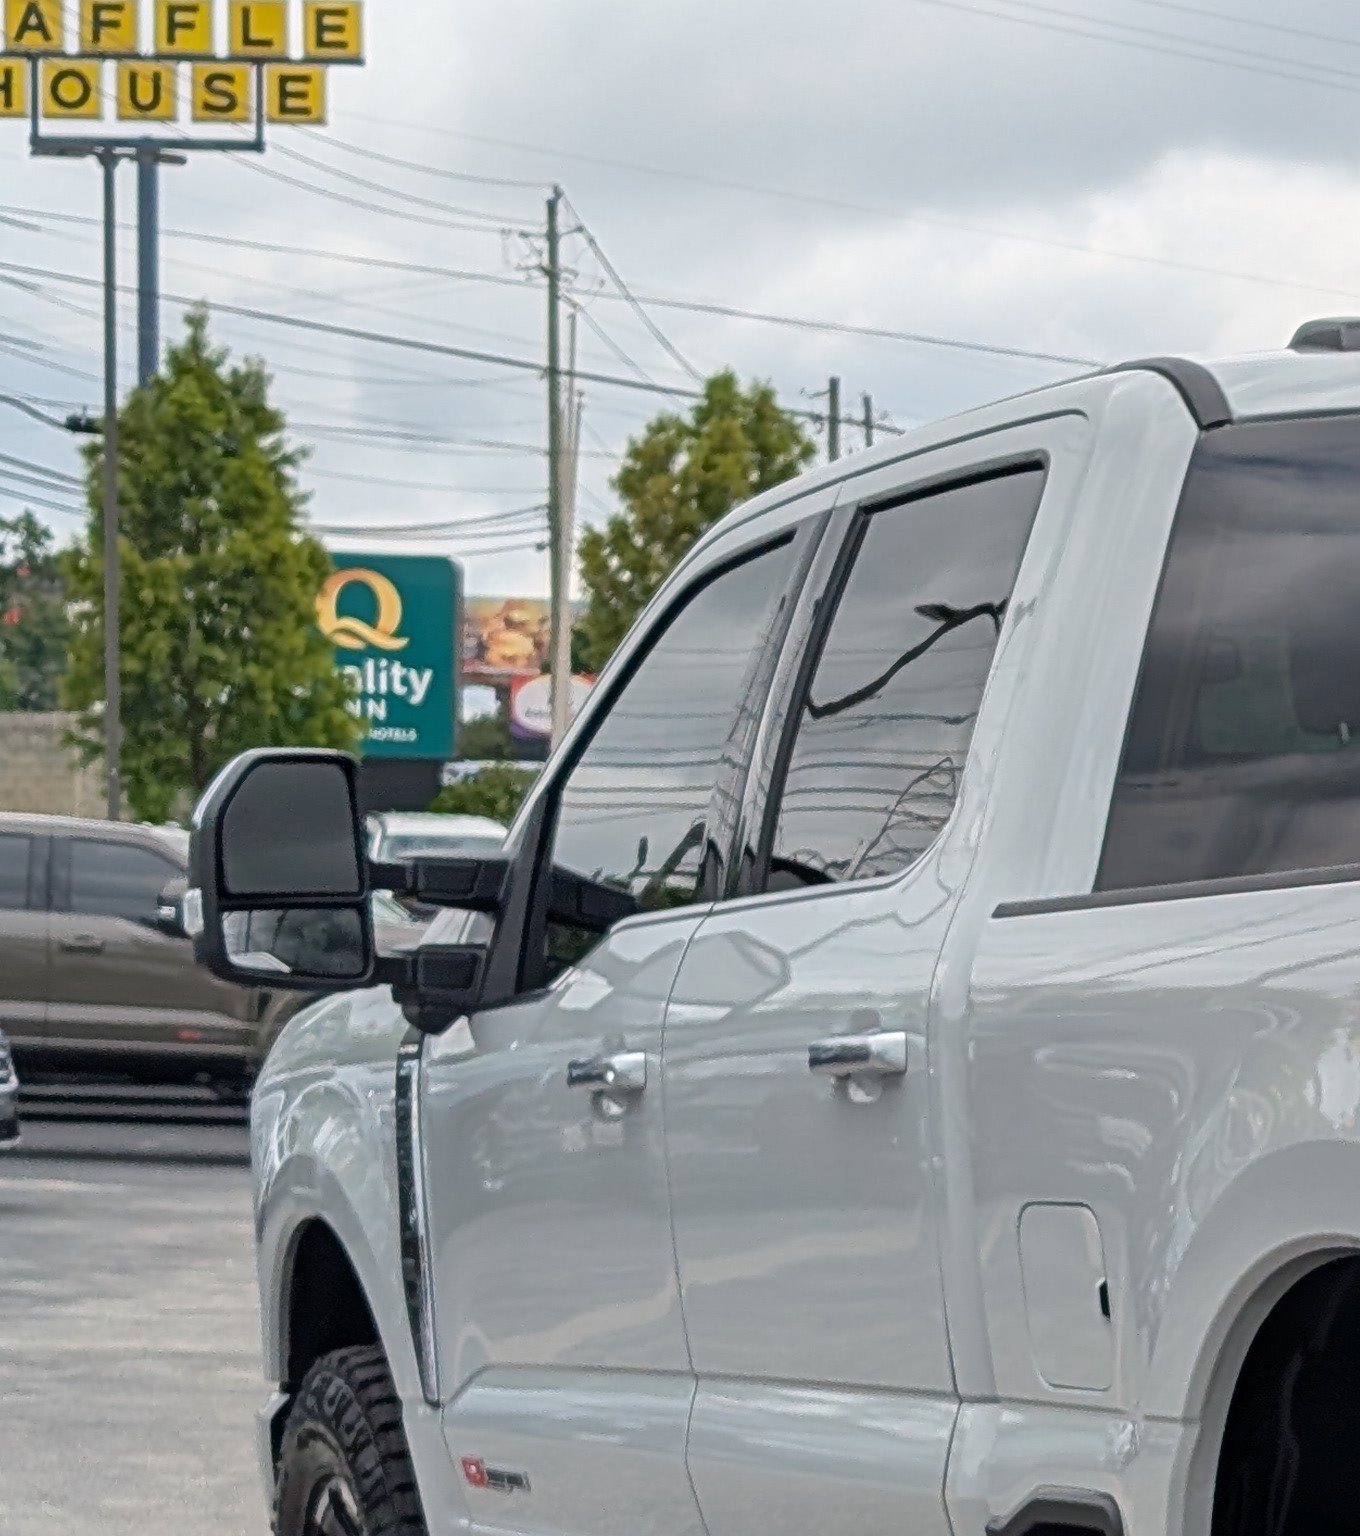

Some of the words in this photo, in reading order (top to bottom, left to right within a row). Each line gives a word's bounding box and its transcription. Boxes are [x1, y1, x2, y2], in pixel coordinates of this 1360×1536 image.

[14, 1, 349, 48] AFFLE
[314, 567, 410, 650] Q
[334, 657, 433, 705] ality
[343, 698, 387, 720] NN
